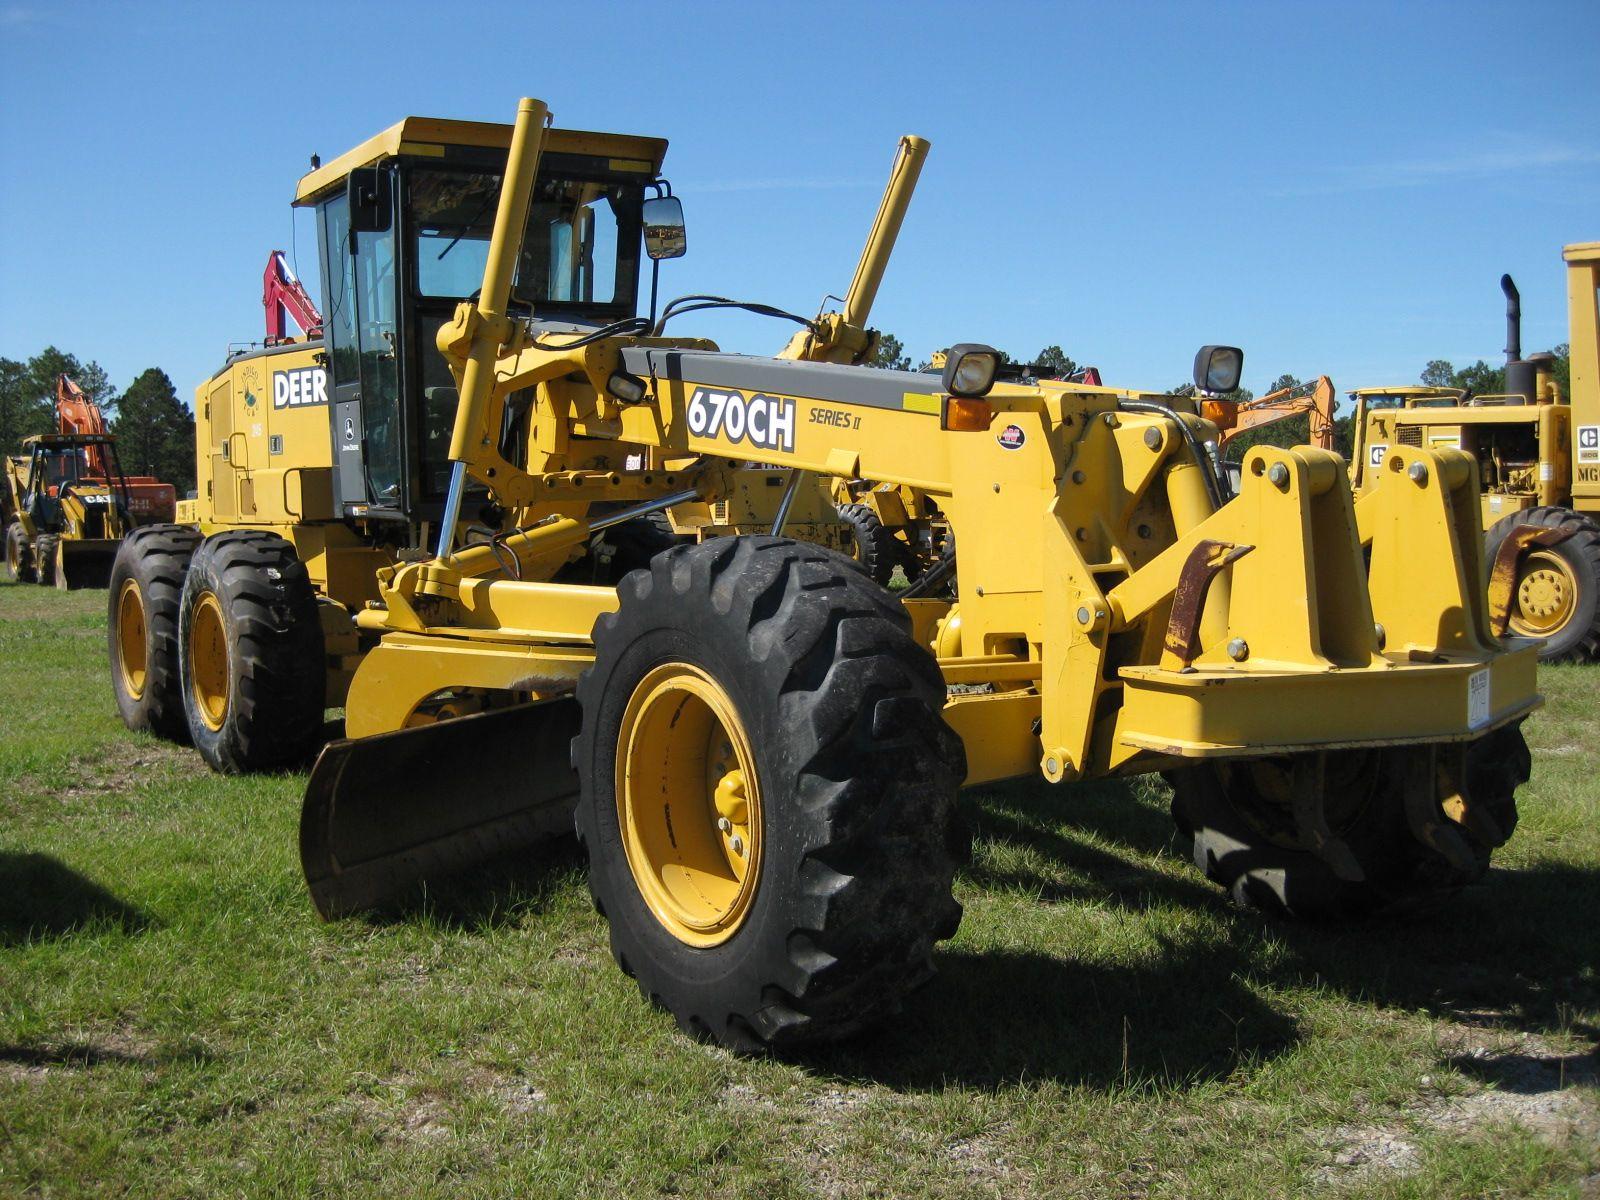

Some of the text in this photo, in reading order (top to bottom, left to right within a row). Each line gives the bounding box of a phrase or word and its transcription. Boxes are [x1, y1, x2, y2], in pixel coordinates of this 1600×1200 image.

[274, 368, 329, 406] DEER
[688, 390, 794, 448] 670CH
[808, 407, 862, 430] SERIES II
[1577, 466, 1600, 482] MG
